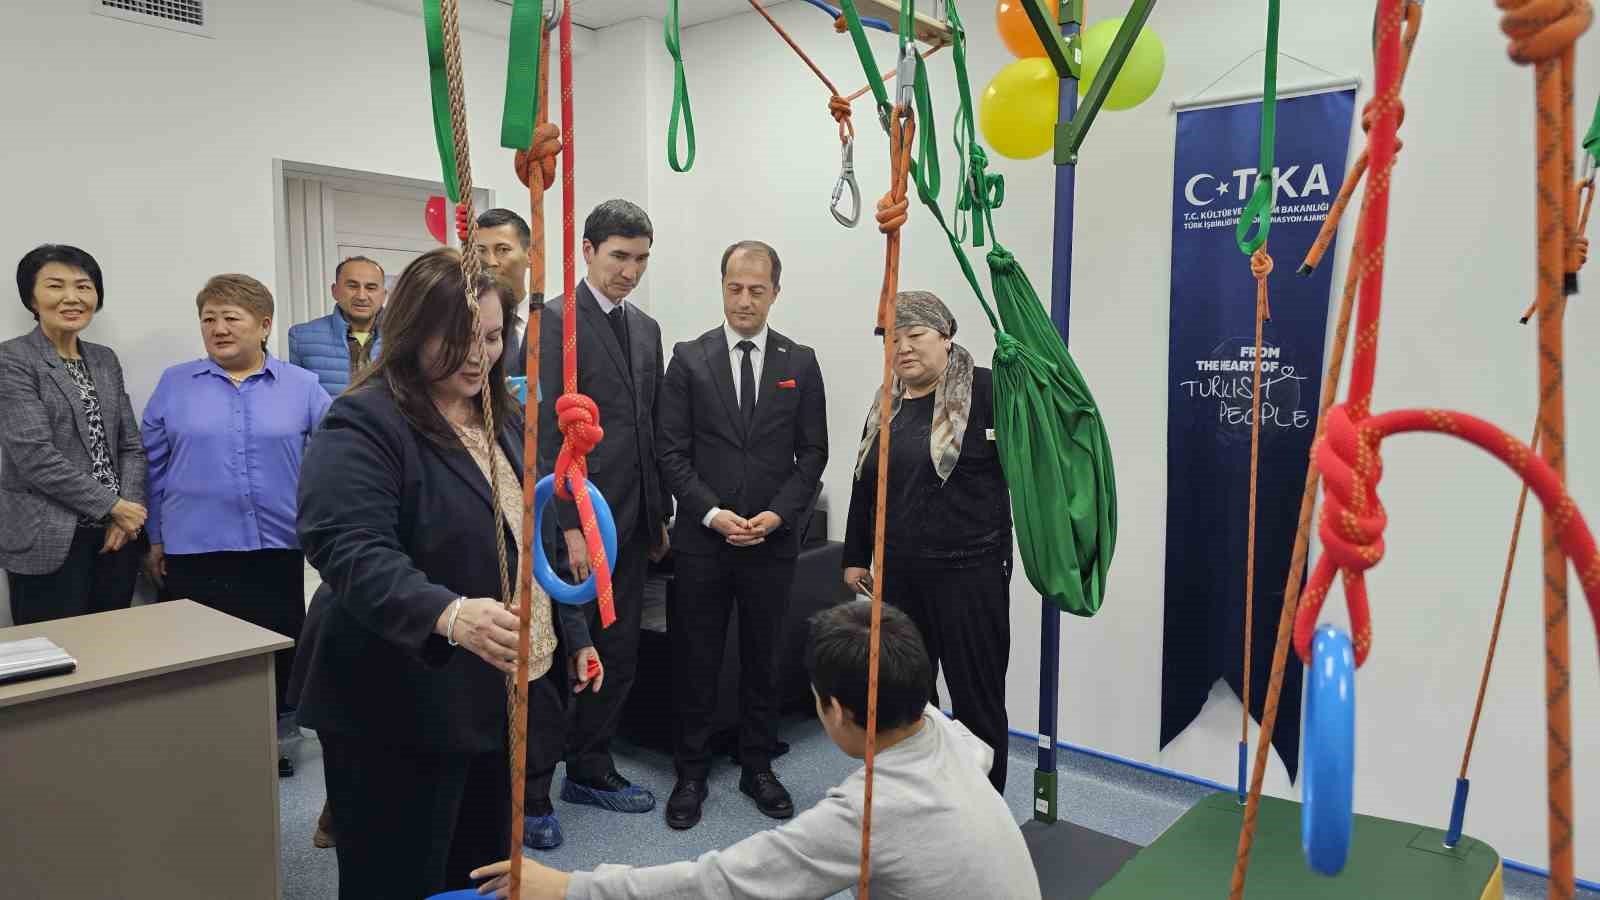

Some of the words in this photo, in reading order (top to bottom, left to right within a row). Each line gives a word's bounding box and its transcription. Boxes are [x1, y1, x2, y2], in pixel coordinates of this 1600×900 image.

[1233, 163, 1330, 200] TKA
[1183, 212, 1199, 221] T.C.
[1240, 346, 1281, 359] FROM
[1195, 360, 1219, 371] THE
[1260, 361, 1280, 373] OF
